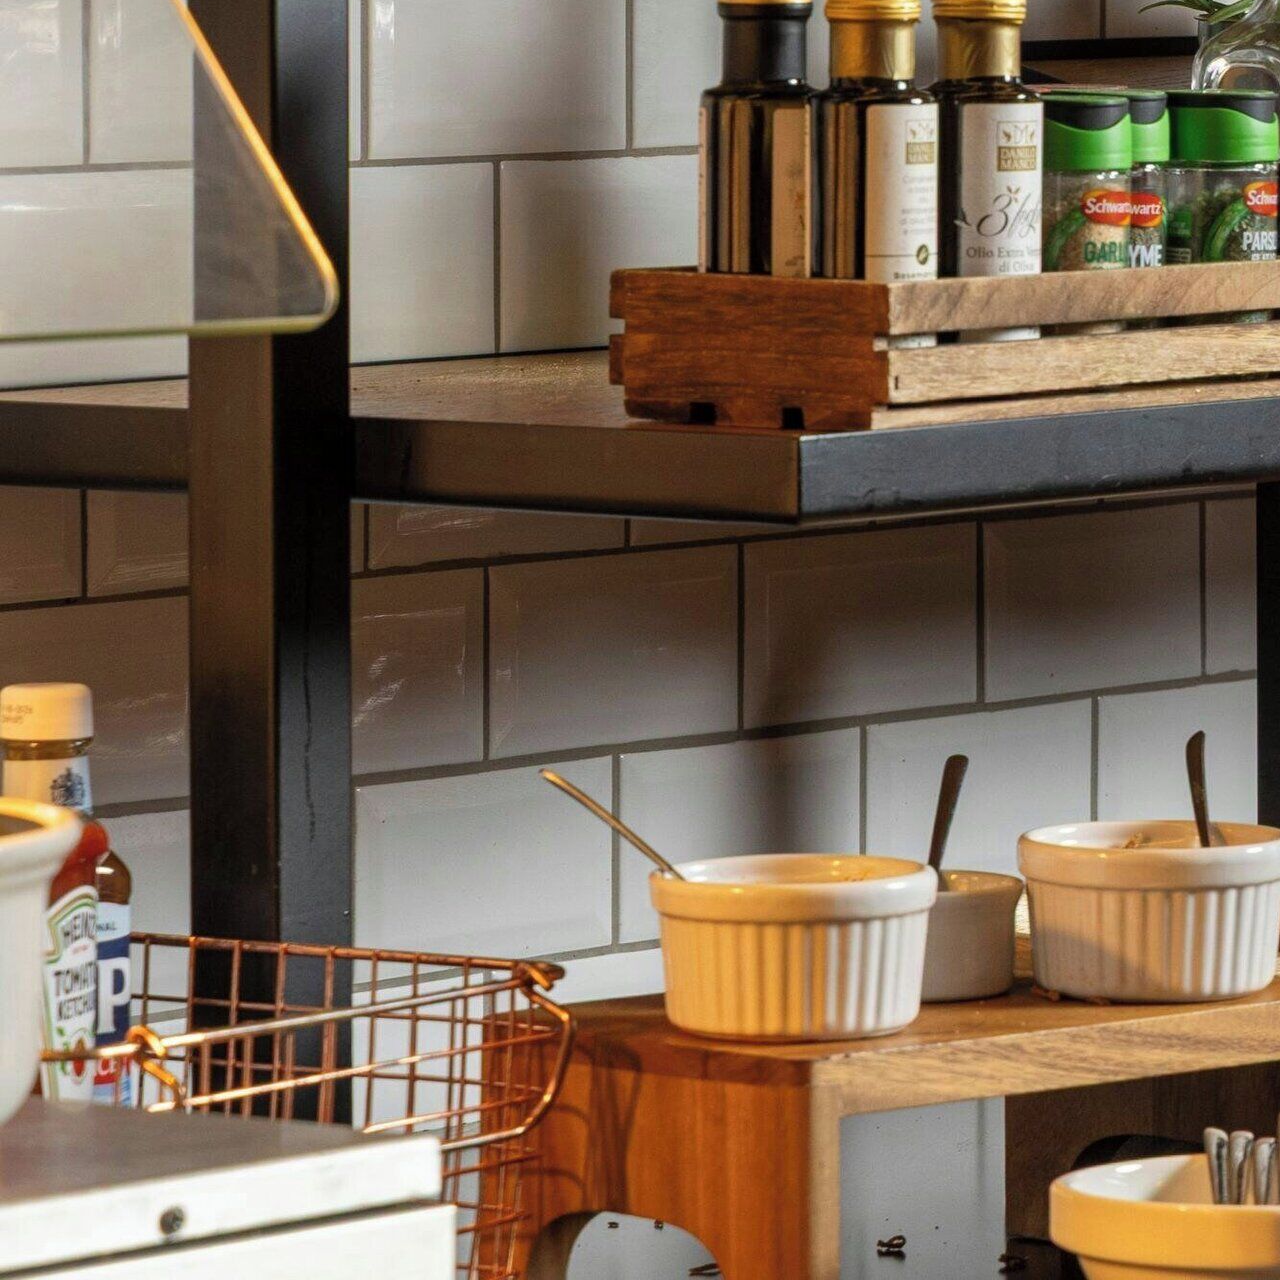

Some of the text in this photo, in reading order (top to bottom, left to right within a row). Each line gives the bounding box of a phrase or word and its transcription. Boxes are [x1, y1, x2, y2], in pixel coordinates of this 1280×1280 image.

[966, 246, 994, 259] Olio
[1084, 241, 1125, 264] GARL
[1128, 244, 1163, 268] YME
